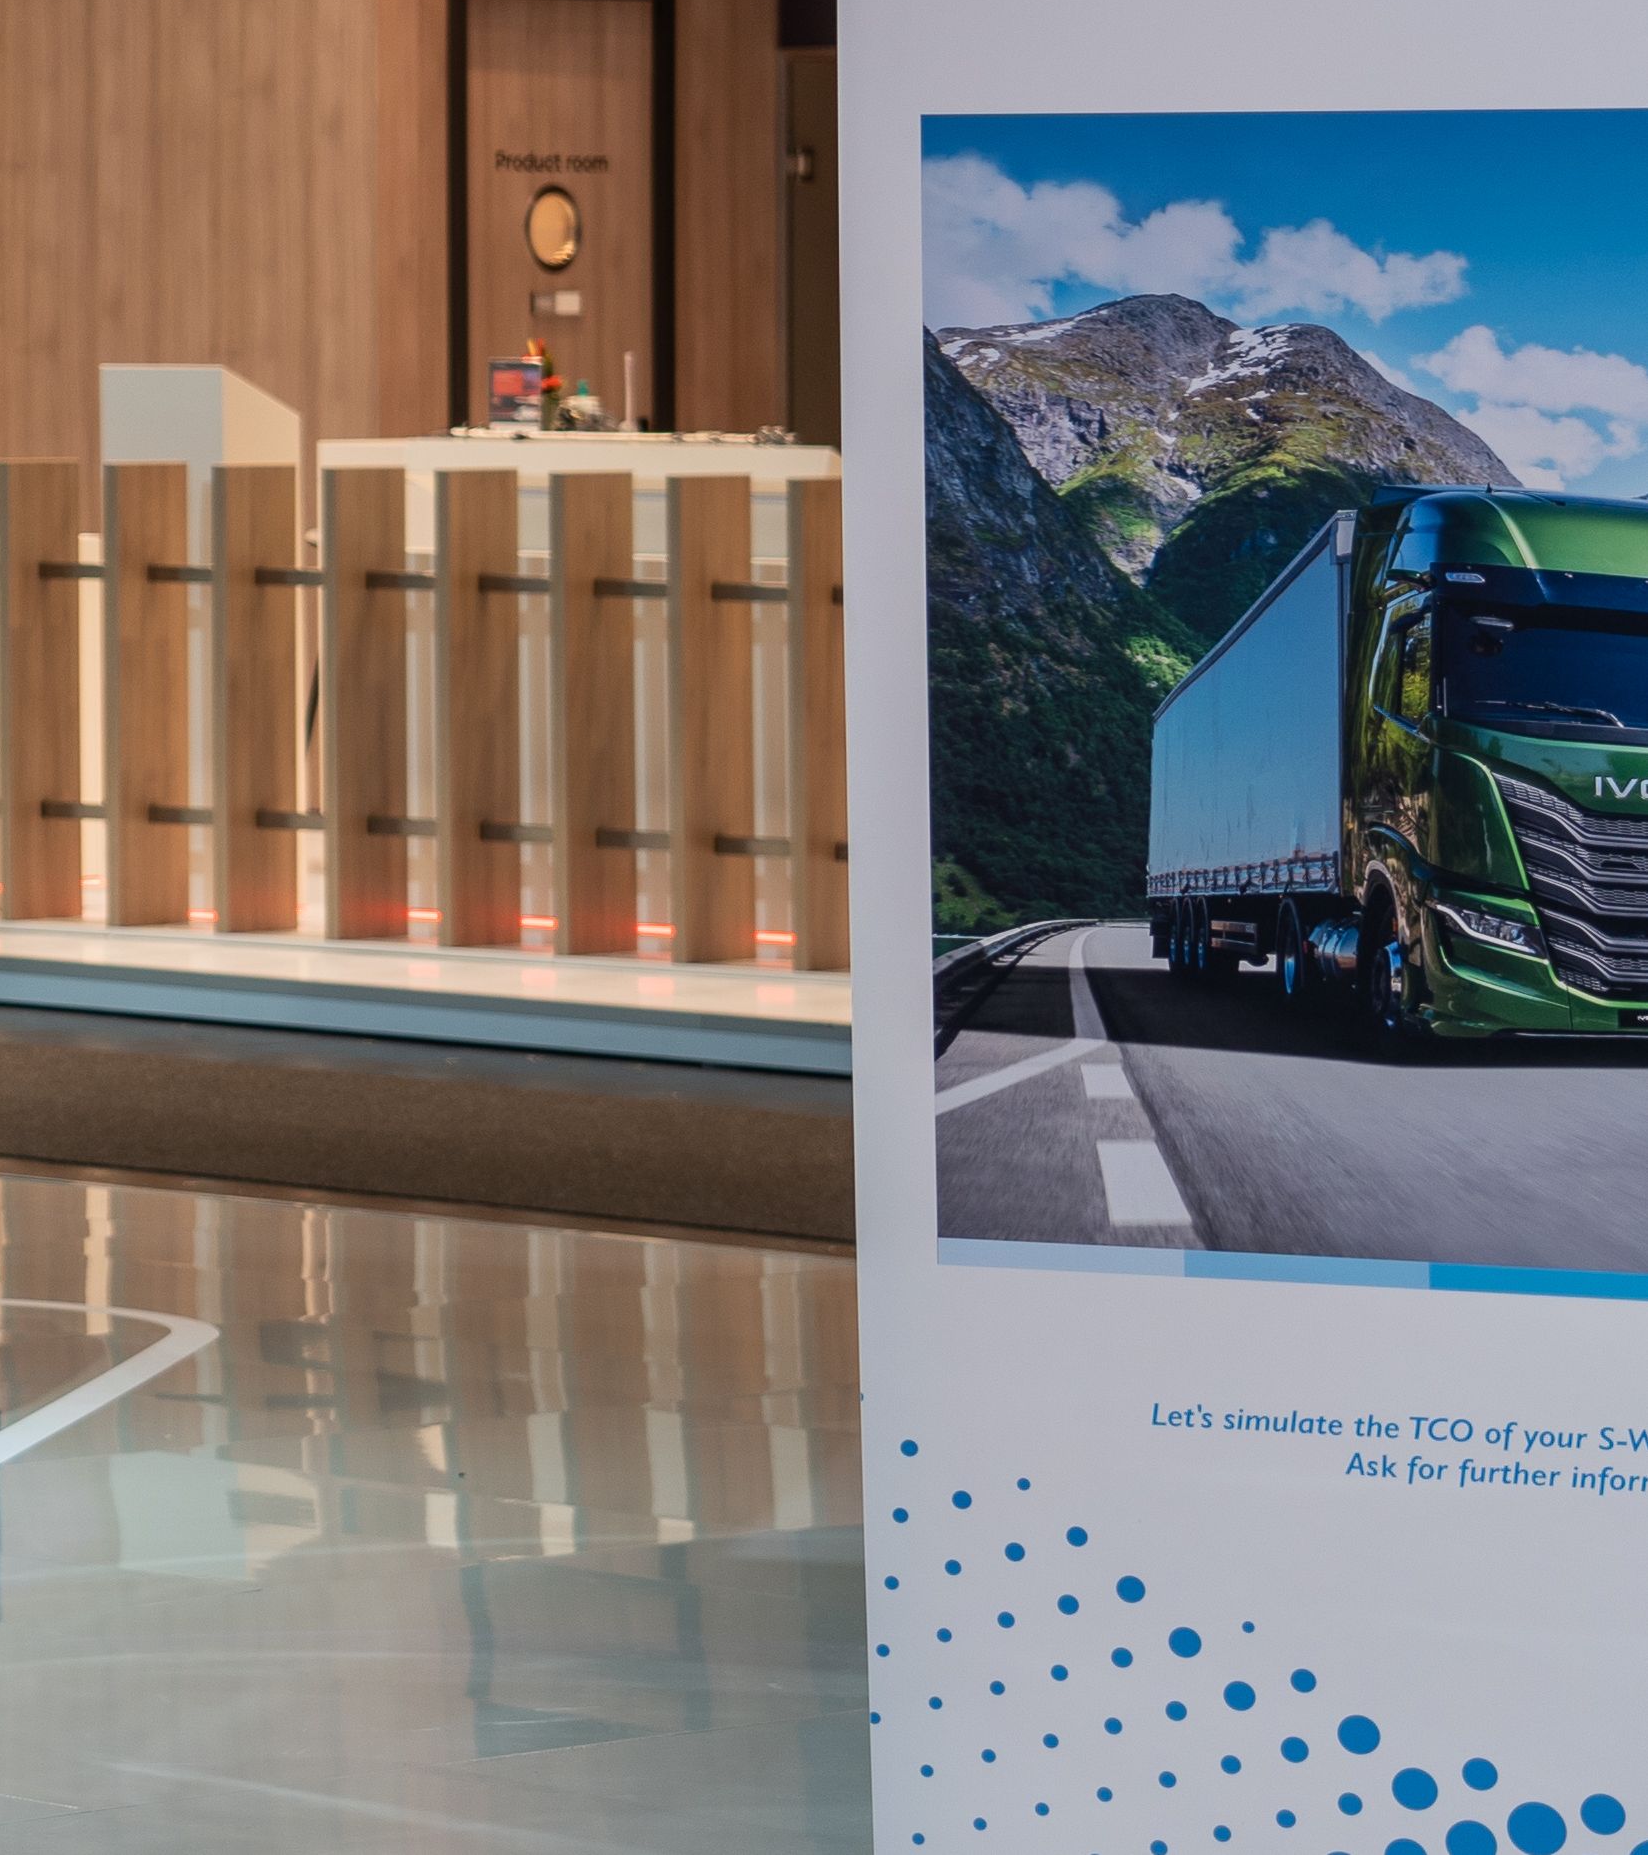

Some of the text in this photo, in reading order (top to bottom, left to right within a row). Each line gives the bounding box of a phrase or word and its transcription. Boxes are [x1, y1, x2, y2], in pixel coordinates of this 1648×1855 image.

[495, 149, 609, 174] Product room
[1151, 1403, 1213, 1431] Let's
[1223, 1408, 1343, 1437] simulate
[1354, 1415, 1400, 1440] the
[1409, 1416, 1473, 1443] TCO
[1485, 1421, 1518, 1450] of
[1524, 1430, 1588, 1454] your
[1346, 1452, 1398, 1479] Ask
[1407, 1455, 1448, 1485] for
[1458, 1458, 1561, 1489] further
